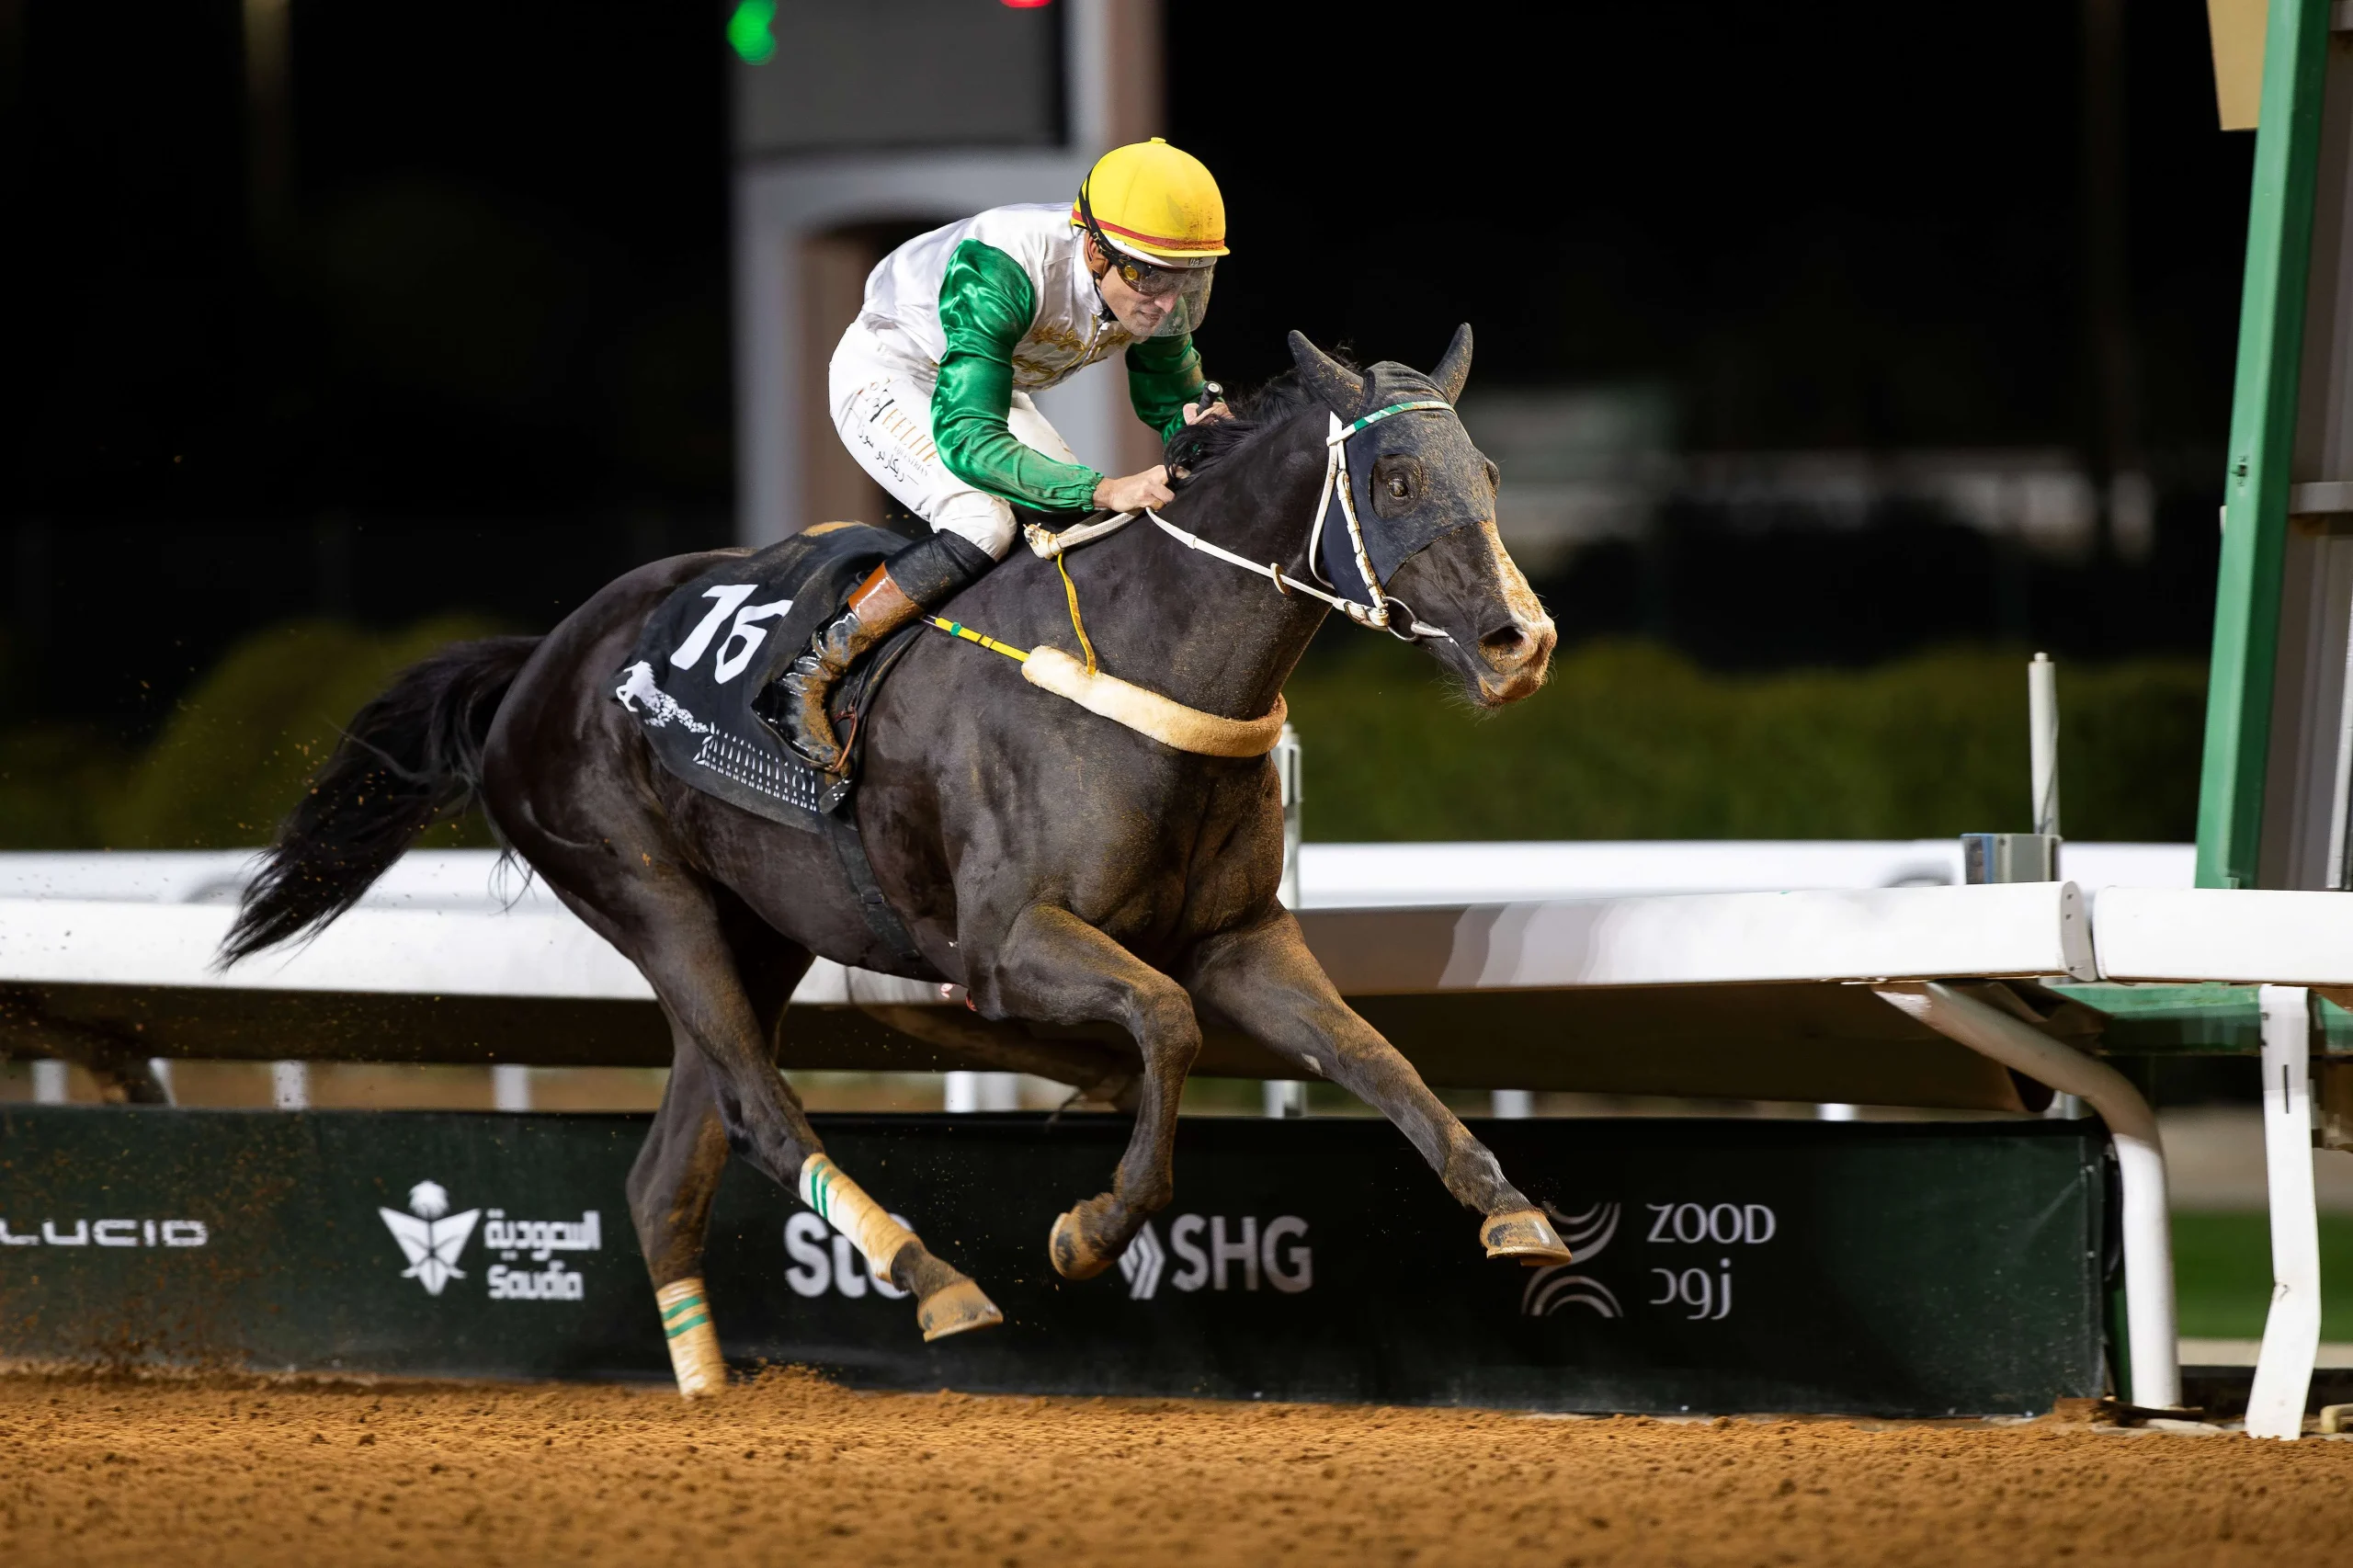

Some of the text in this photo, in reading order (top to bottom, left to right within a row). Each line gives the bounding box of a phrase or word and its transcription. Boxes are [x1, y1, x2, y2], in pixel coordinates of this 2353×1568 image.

[669, 584, 794, 685] 16
[0, 1218, 210, 1247] LUCID
[484, 1208, 602, 1261] السعودية
[1645, 1202, 1777, 1244] ZOOD
[1170, 1214, 1313, 1292] SHG
[487, 1260, 585, 1301] Saudia
